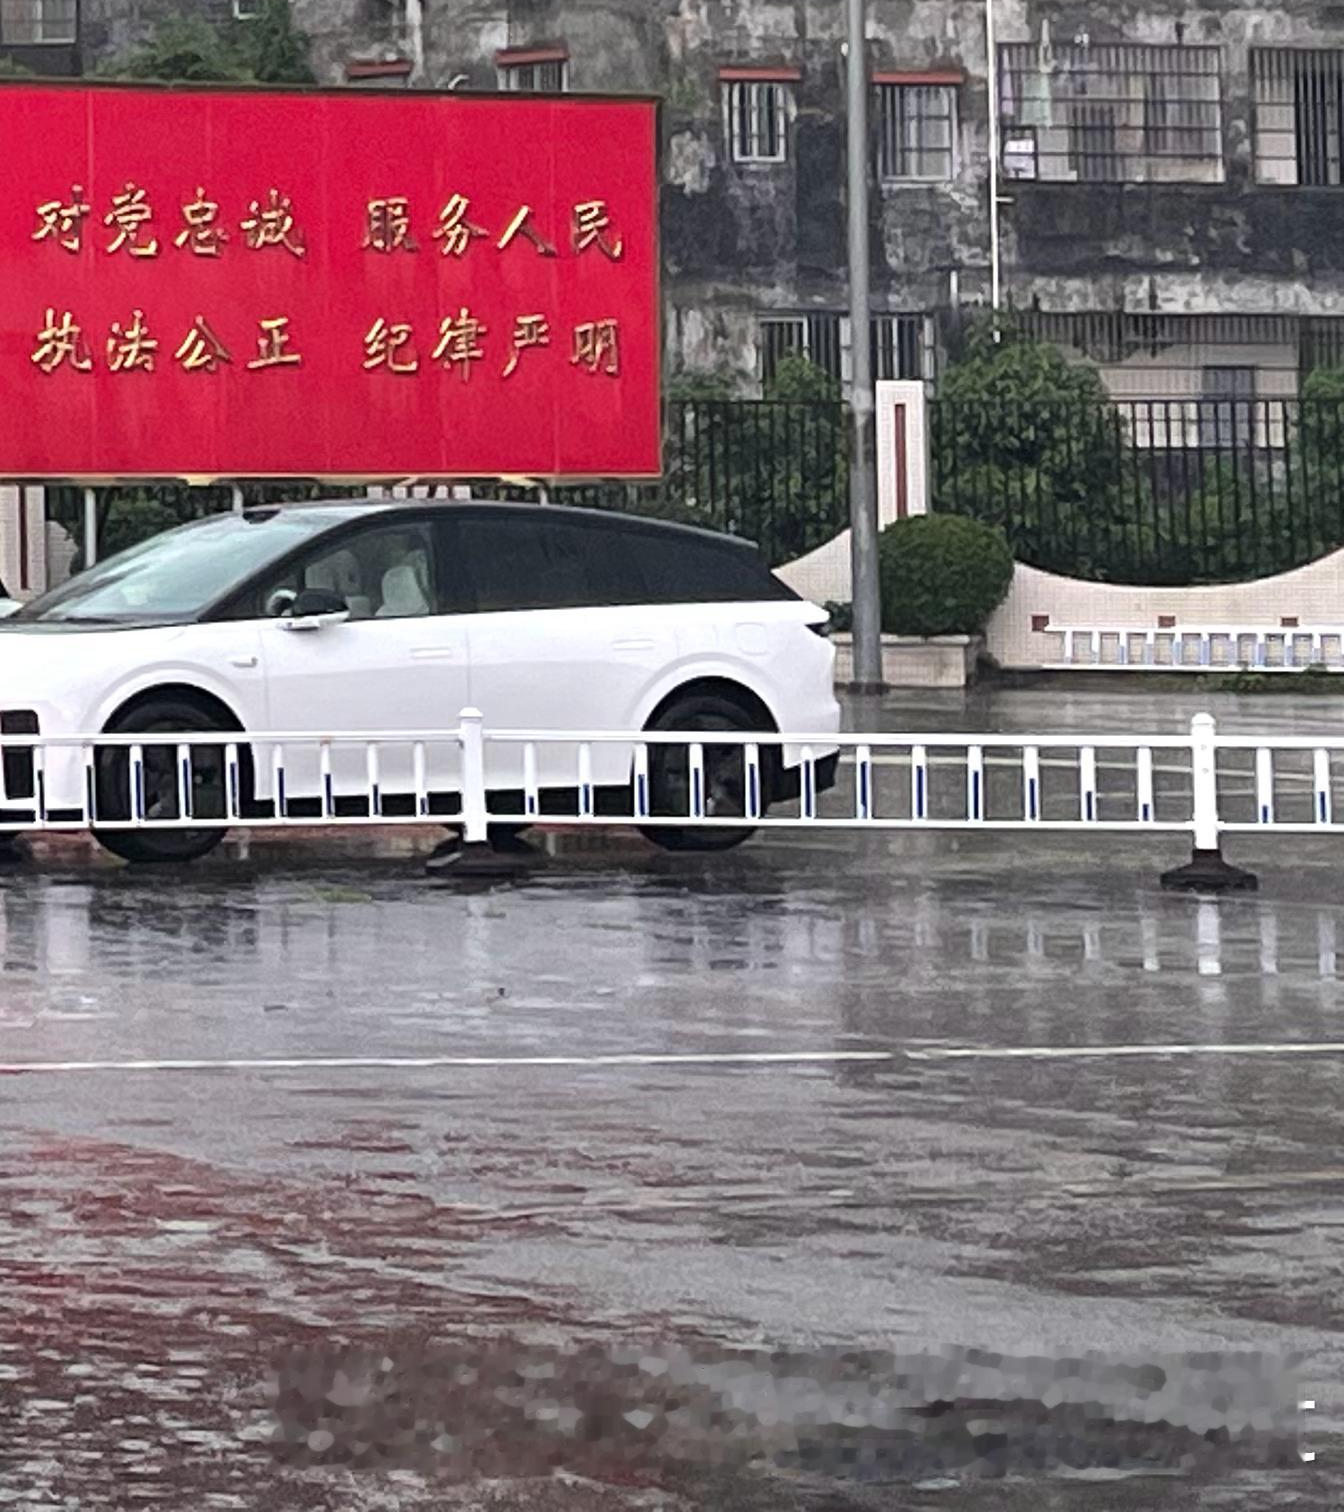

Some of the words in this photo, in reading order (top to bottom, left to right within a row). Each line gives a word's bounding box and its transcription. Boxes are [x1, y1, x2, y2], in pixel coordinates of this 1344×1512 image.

[30, 182, 306, 258] 对党忠诚
[361, 192, 624, 259] 服务人民
[30, 308, 303, 375] 执法公正
[363, 307, 621, 383] 纪律严明
